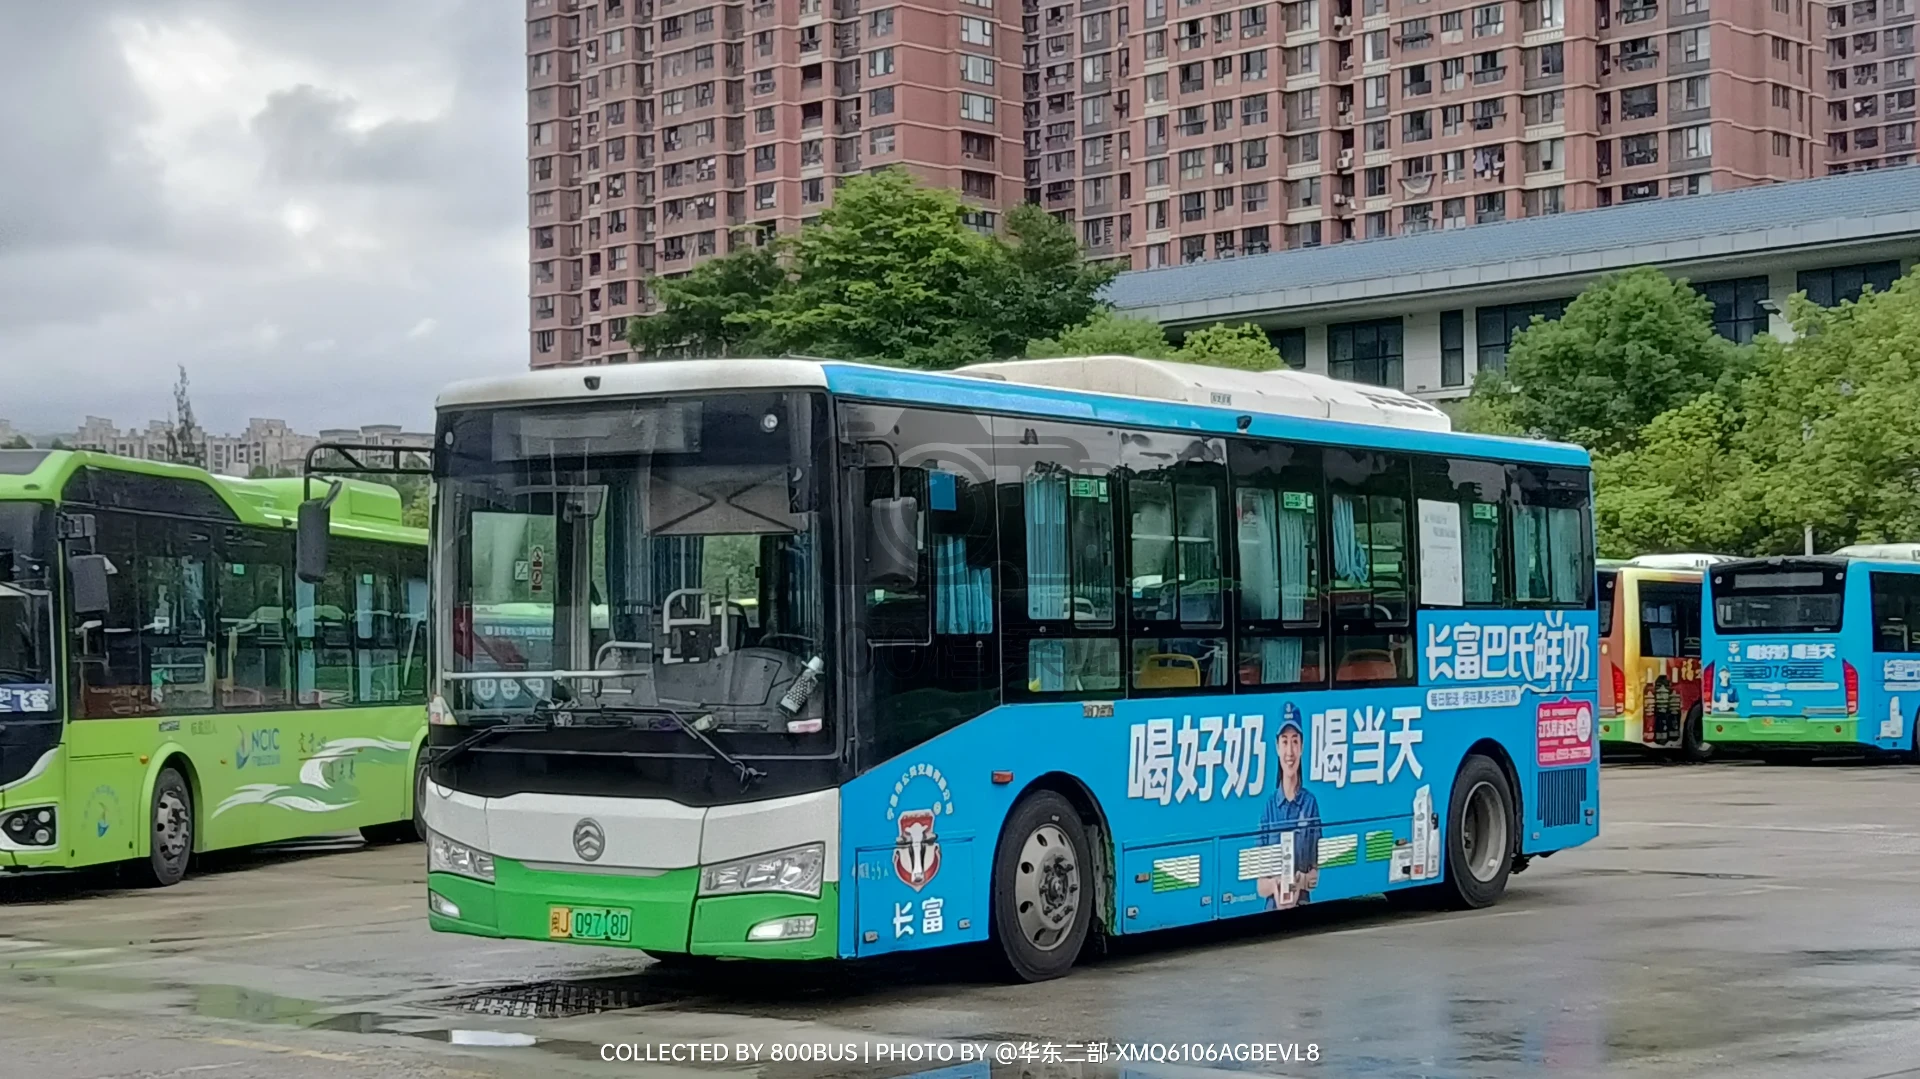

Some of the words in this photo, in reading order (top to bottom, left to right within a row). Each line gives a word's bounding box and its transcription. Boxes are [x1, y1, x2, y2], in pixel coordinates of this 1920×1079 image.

[1425, 610, 1590, 692] 长富巴氏鲜奶
[1127, 714, 1266, 806] 喝好奶
[1309, 705, 1423, 788] 喝当天
[893, 897, 944, 938] 长富
